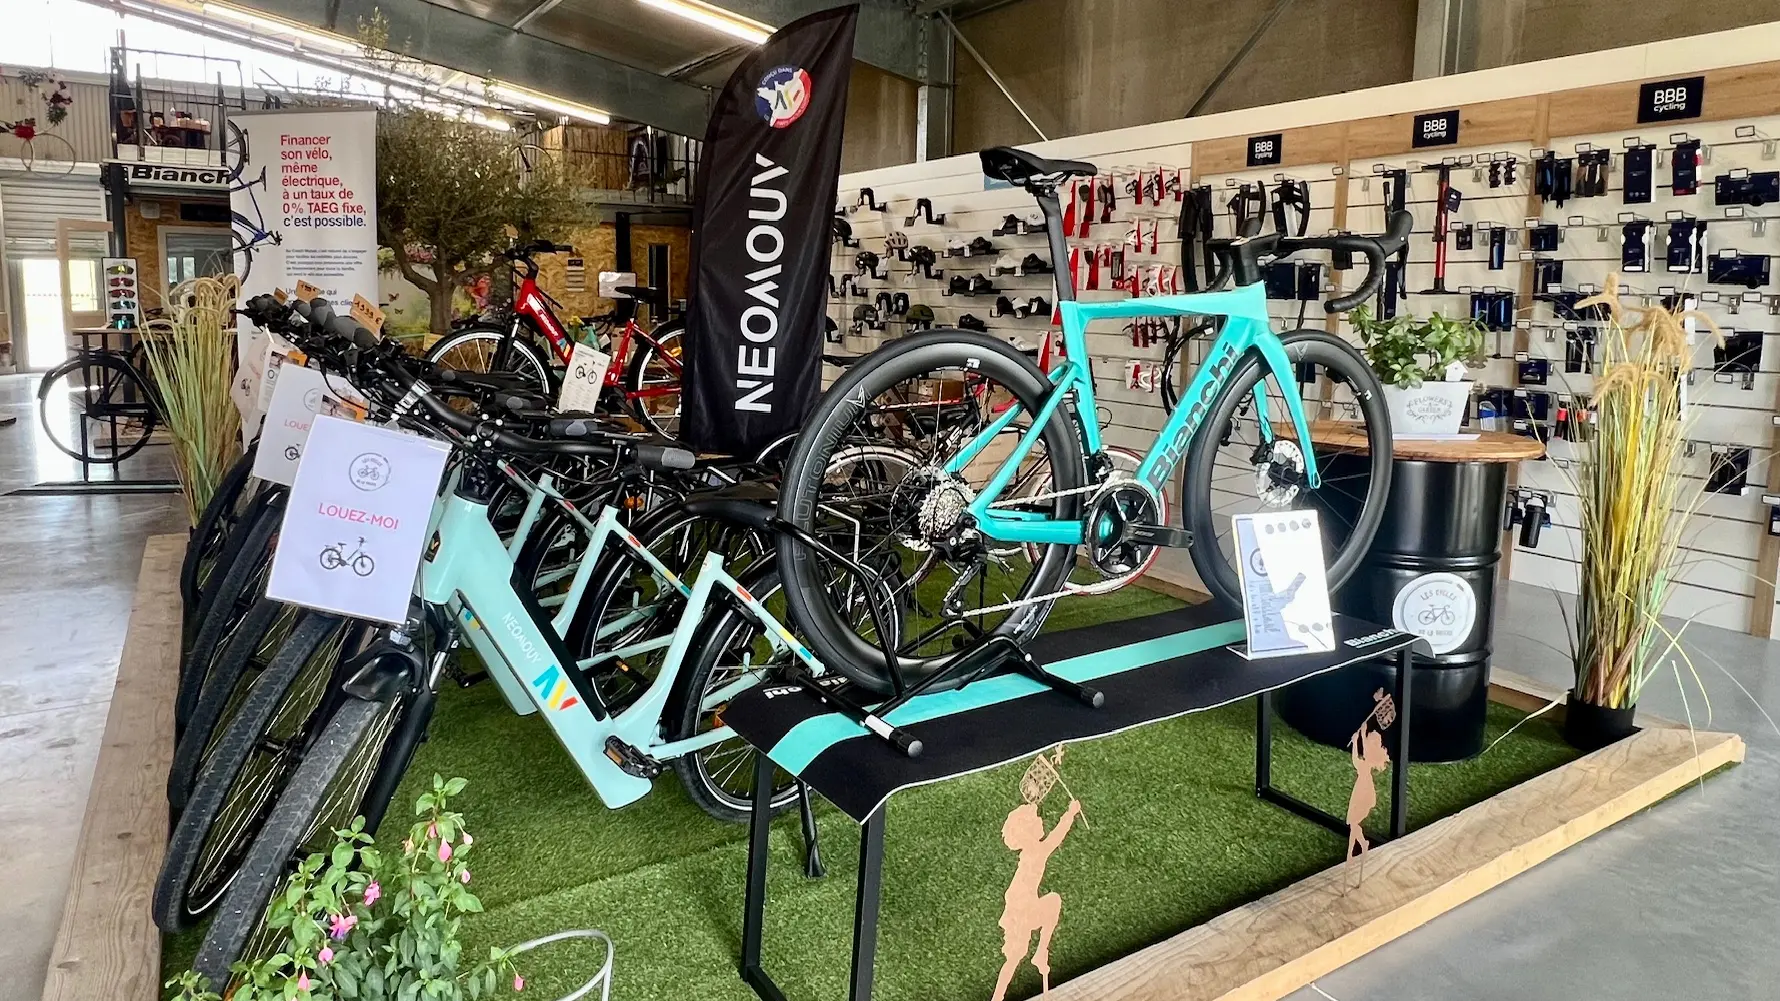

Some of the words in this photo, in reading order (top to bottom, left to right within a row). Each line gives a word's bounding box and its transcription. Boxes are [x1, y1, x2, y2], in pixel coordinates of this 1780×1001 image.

[1653, 87, 1687, 105] BBB
[1653, 102, 1686, 113] cycling
[1423, 118, 1448, 132] BBB
[280, 134, 332, 146] Financer
[1423, 130, 1447, 139] cycling
[1254, 140, 1273, 152] BBB
[280, 150, 302, 160] son
[305, 147, 333, 161] vélo,
[131, 164, 230, 185] Bianch
[281, 162, 318, 173] même
[281, 174, 344, 188] électrique,
[282, 189, 290, 200] à
[293, 190, 308, 200] un
[310, 189, 335, 200] taux
[338, 188, 354, 199] de
[307, 202, 339, 214] TAEG
[341, 201, 367, 216] fixe,
[283, 214, 312, 227] c'est
[314, 214, 367, 229] possible.
[734, 152, 790, 414] NEOMOUV
[326, 288, 337, 296] qui
[1413, 395, 1448, 406] FLOWERS
[1146, 341, 1240, 491] Bianchi
[283, 418, 311, 431] LOUE
[318, 502, 399, 530] LOUEZ-MOI
[1420, 590, 1434, 601] LES
[501, 612, 542, 664] NEOMOUV
